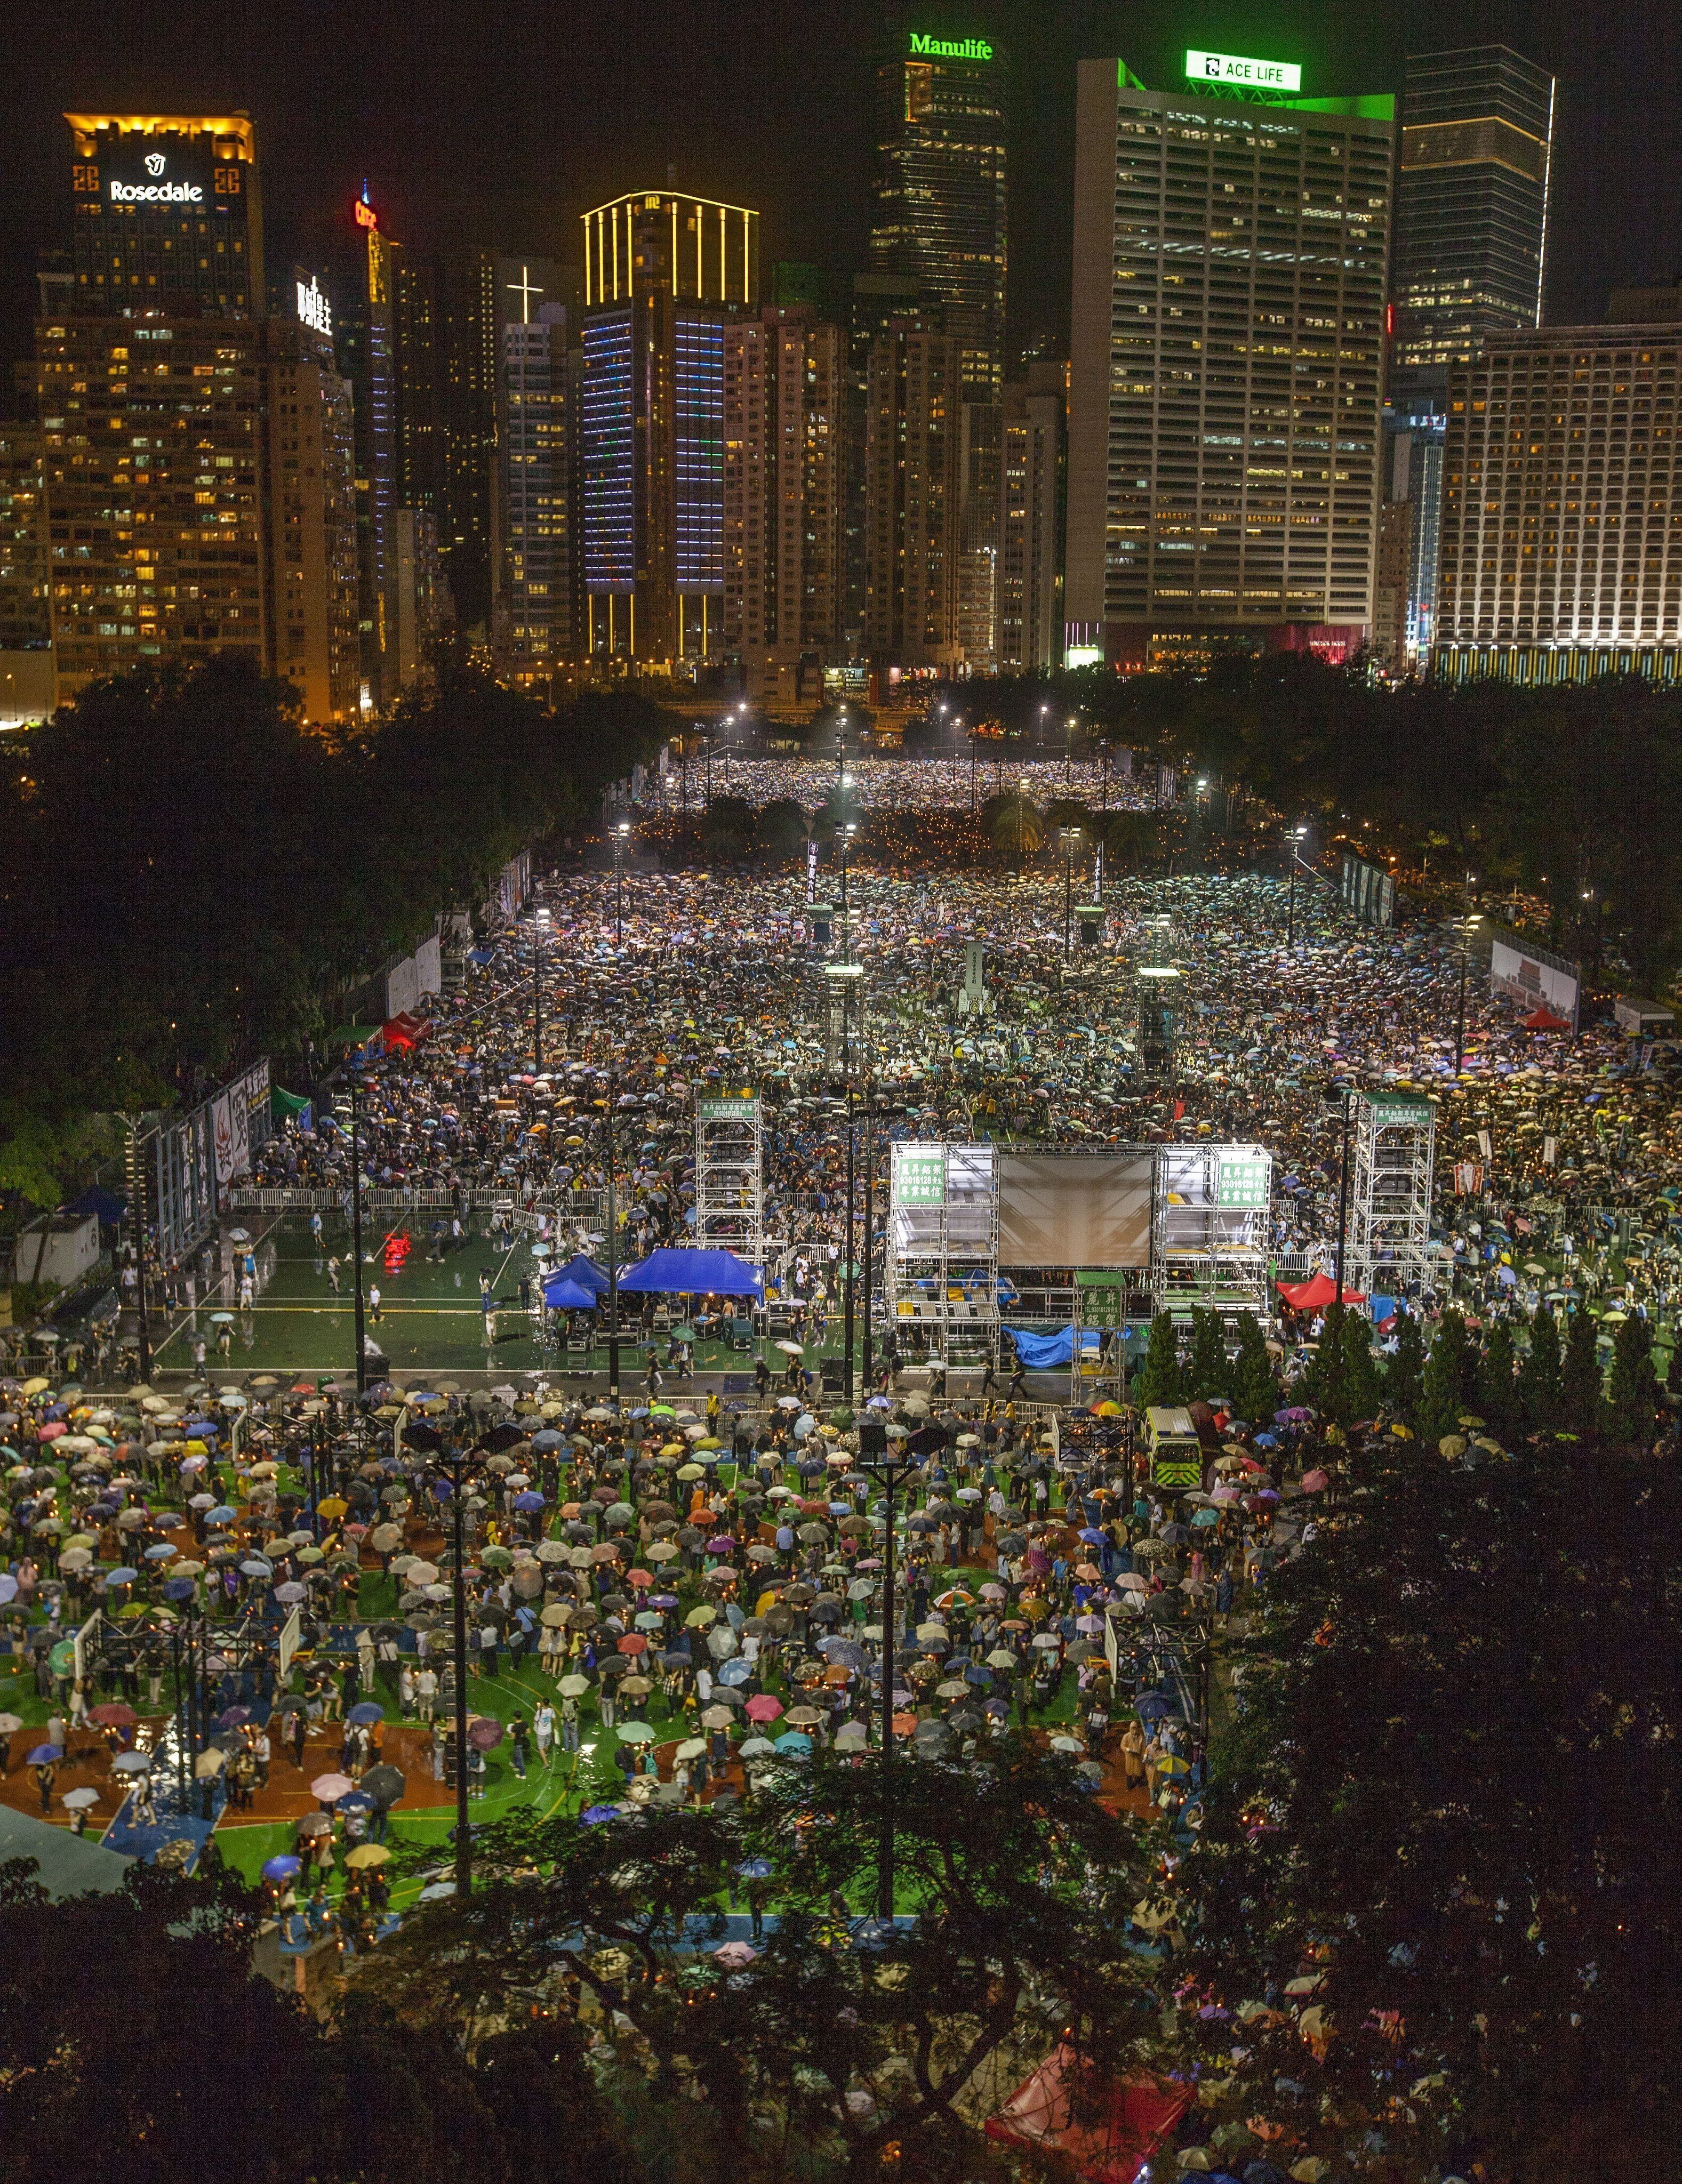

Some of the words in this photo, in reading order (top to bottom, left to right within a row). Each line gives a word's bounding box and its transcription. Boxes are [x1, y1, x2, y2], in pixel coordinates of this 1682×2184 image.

[910, 33, 993, 59] Manulife
[1226, 63, 1251, 78] ACE
[1258, 67, 1283, 82] LIFE
[110, 181, 203, 202] Rosedale
[900, 1176, 932, 1184] 93016128
[900, 1185, 941, 1198] 專業誠信
